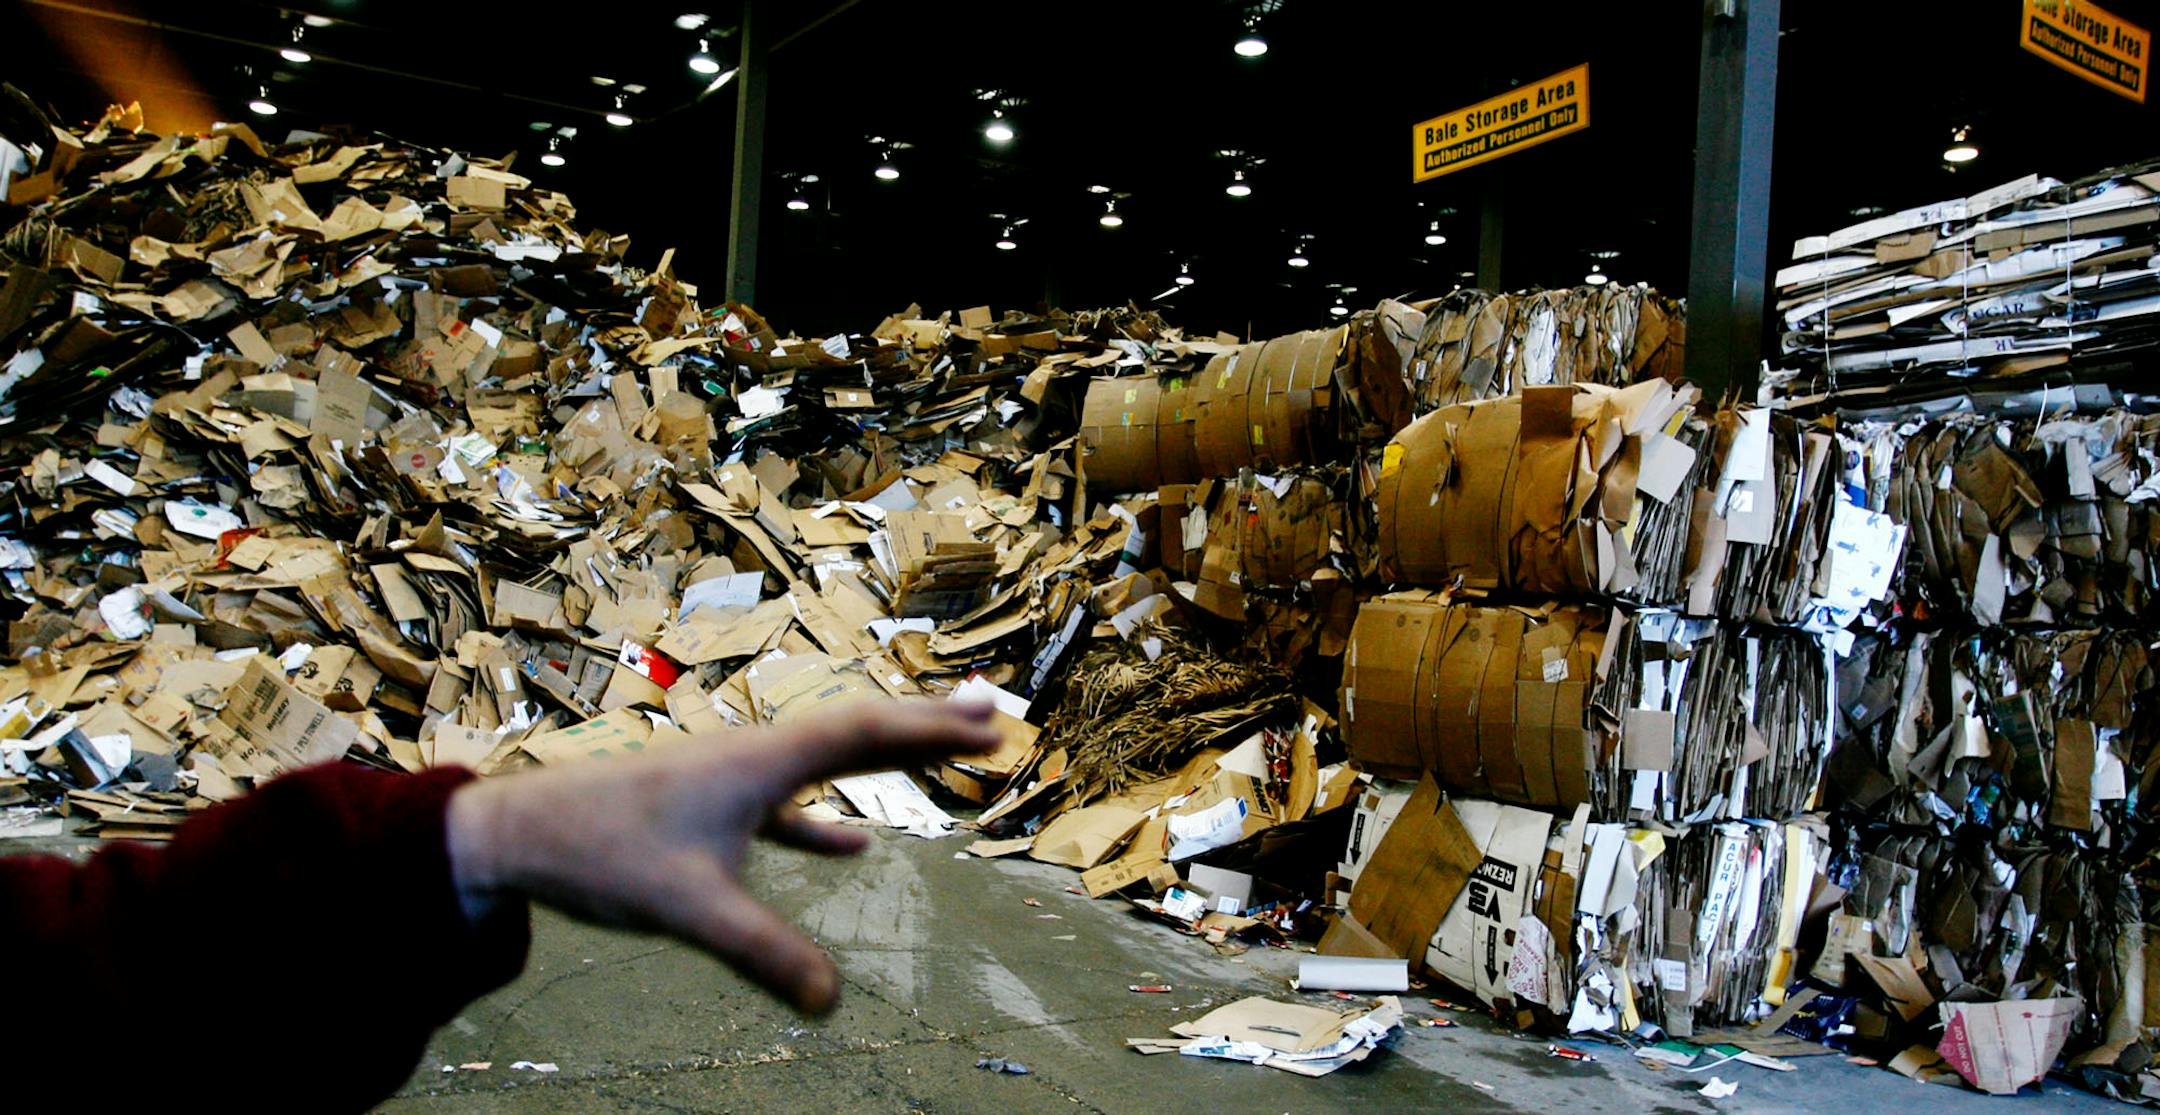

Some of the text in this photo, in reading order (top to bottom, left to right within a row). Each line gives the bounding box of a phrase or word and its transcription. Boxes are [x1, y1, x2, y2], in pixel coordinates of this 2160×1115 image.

[2032, 20, 2138, 88] Authorized Personnel Only
[2113, 27, 2141, 59] Area
[1425, 80, 1575, 146] Bale Storage Area
[1426, 107, 1575, 169] Authorized Personnel Only
[304, 712, 326, 737] TOWELS
[1953, 1025, 1972, 1074] DO NOT CUT
